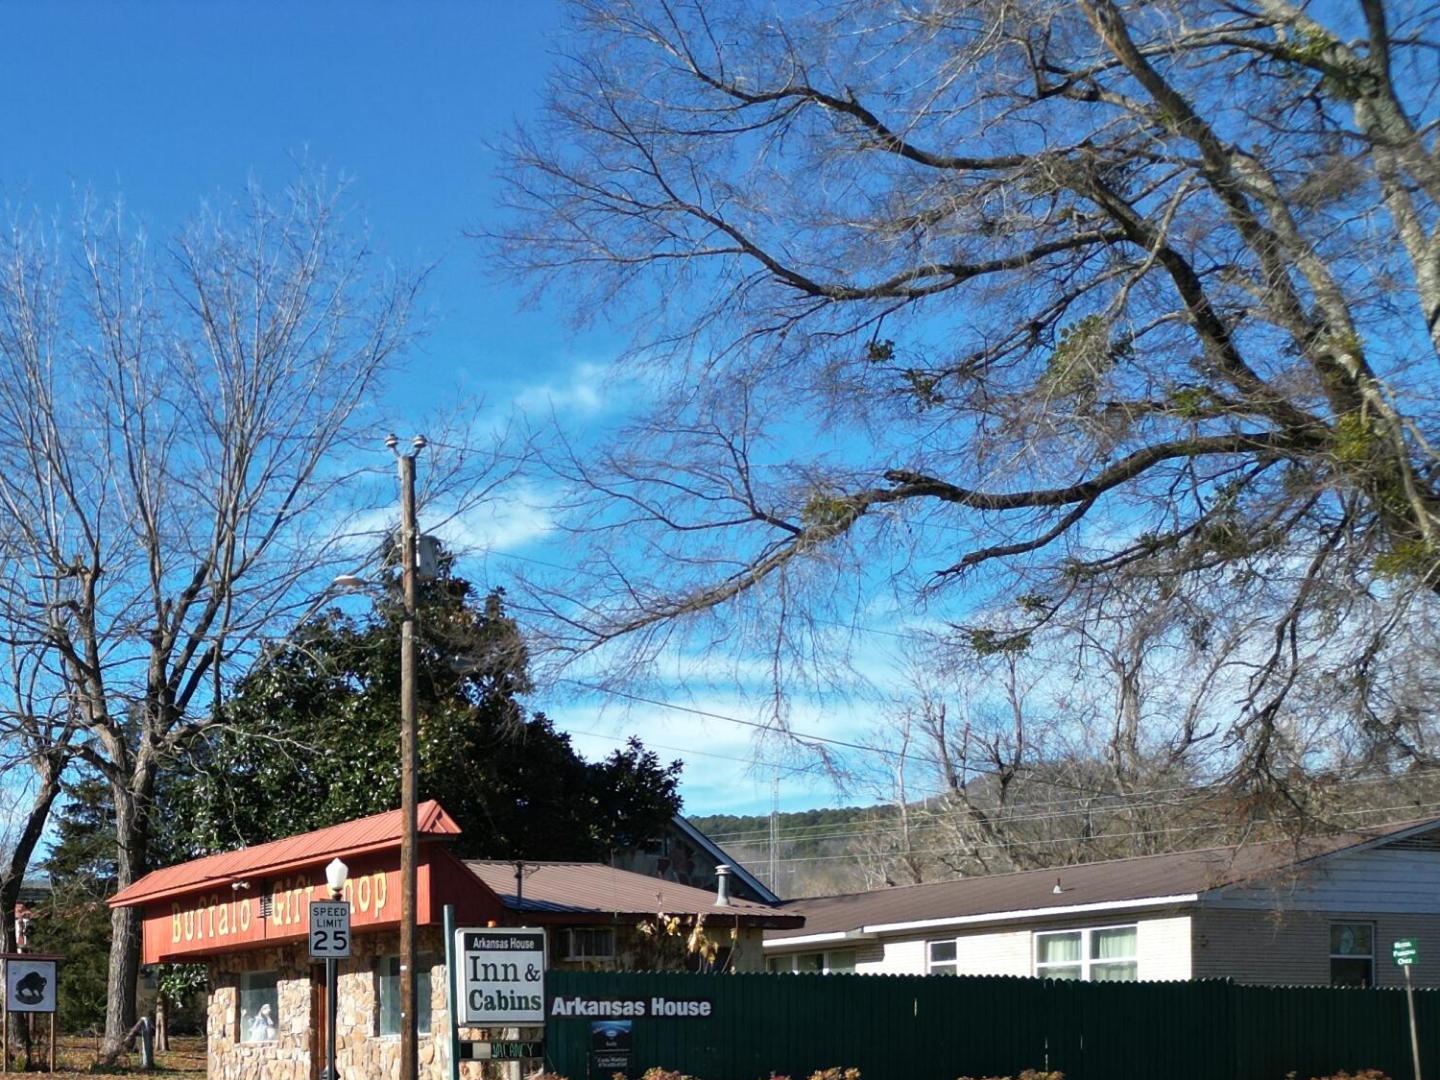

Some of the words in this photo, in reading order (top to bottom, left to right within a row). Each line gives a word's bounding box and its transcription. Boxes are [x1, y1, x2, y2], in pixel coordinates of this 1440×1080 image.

[171, 887, 252, 944] Buffalo
[271, 873, 315, 927] Gift
[326, 869, 387, 919] hop
[312, 907, 347, 917] SPEED
[317, 919, 343, 928] LIMIT
[313, 930, 347, 950] 25
[473, 938, 509, 949] Arkansas
[510, 938, 535, 949] House
[469, 956, 520, 982] Inn
[525, 963, 541, 982] &
[468, 989, 542, 1012] Cabins
[551, 997, 645, 1016] Arkansas
[651, 997, 712, 1016] House
[492, 1042, 534, 1058] VACANCY
